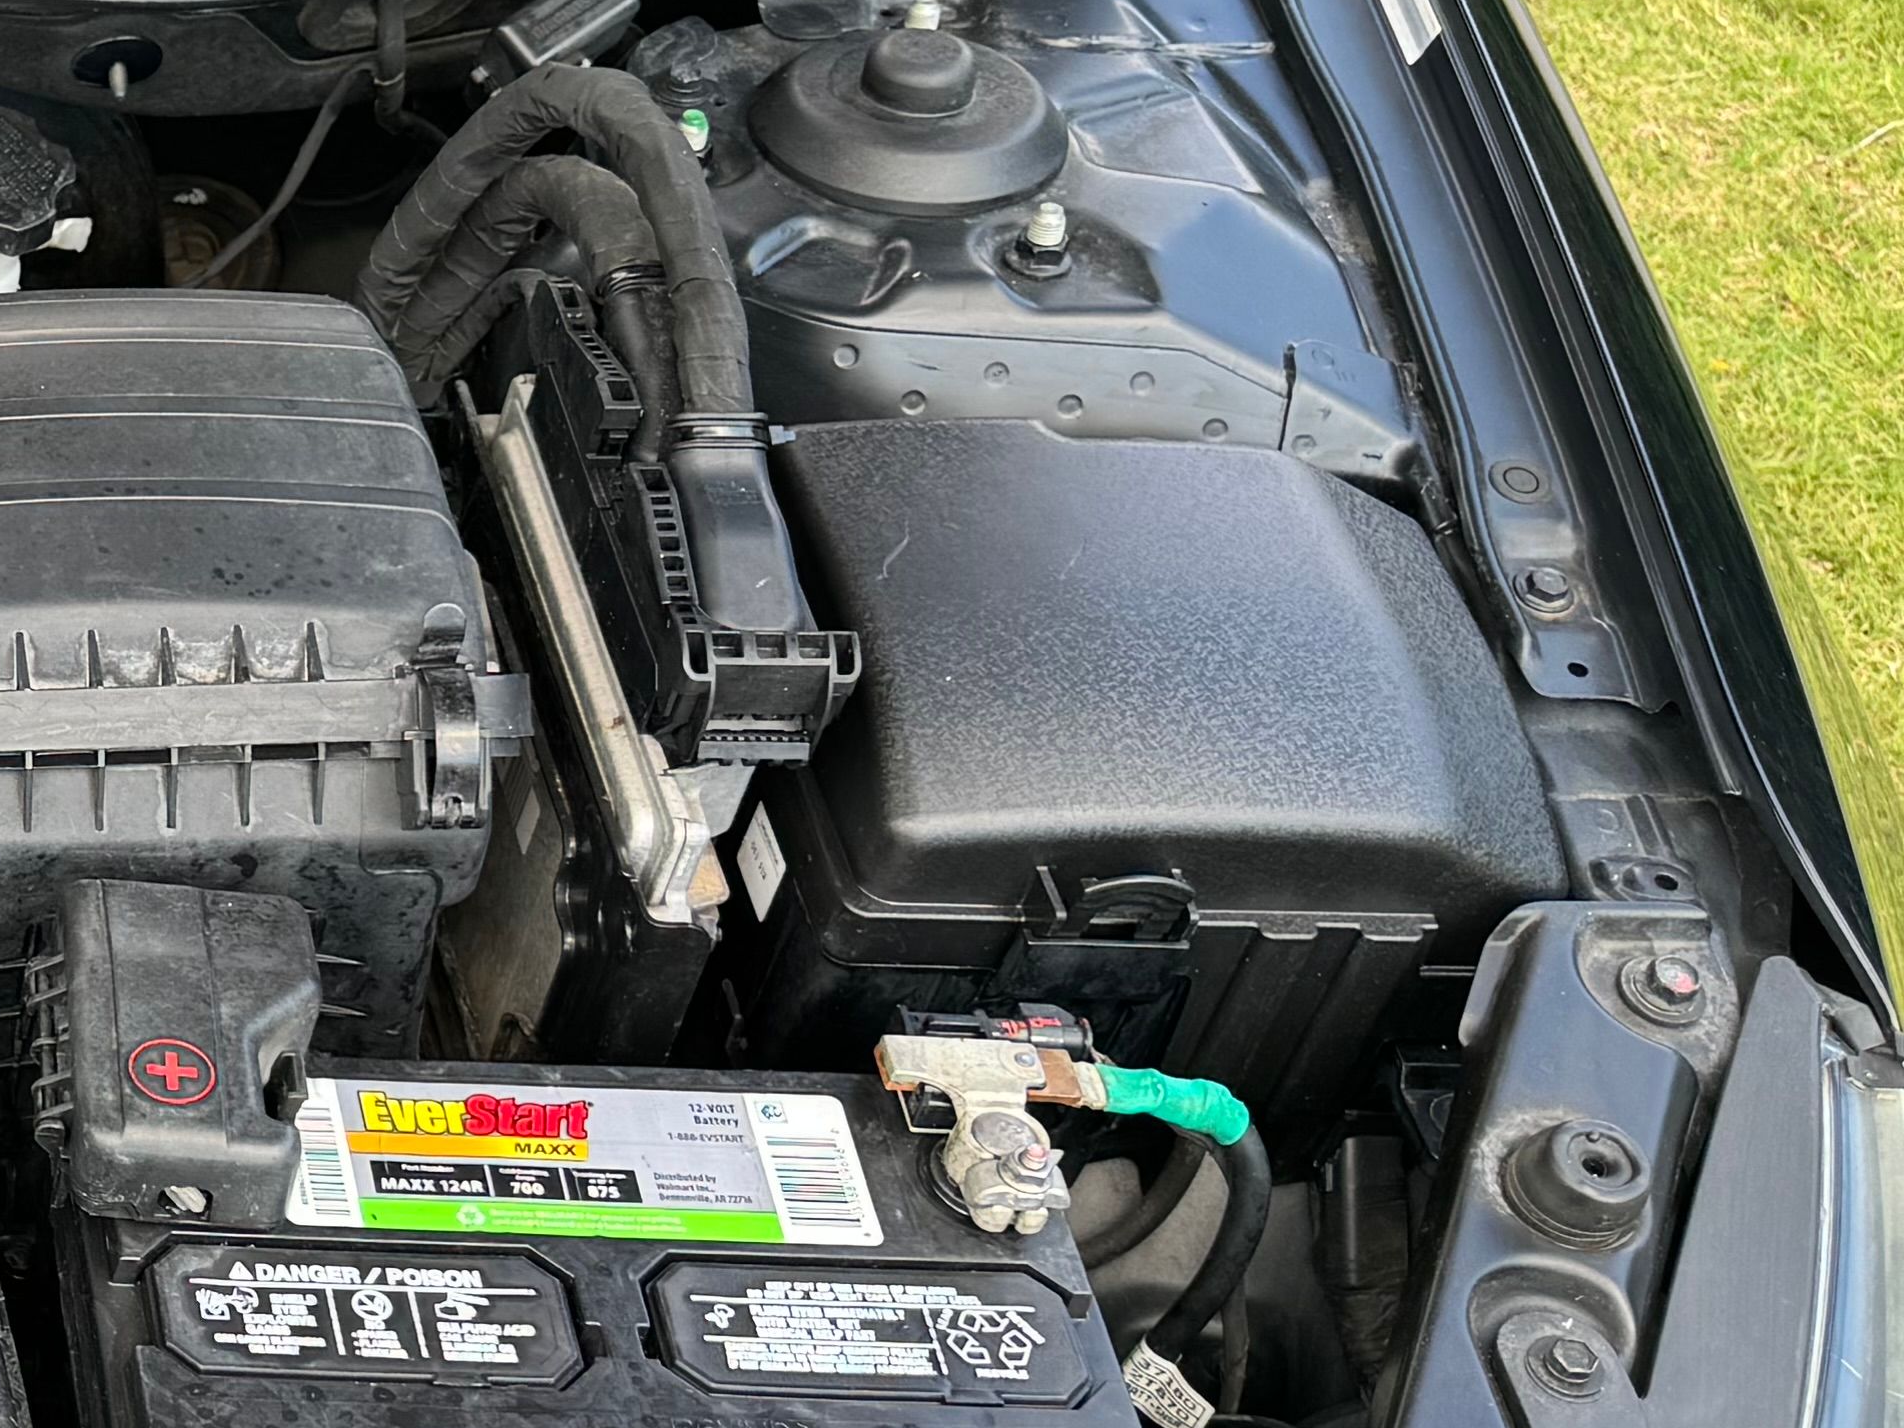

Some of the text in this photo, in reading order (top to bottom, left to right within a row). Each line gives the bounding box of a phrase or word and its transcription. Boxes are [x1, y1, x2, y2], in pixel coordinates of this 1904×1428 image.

[357, 1090, 588, 1139] EverStart
[688, 1102, 736, 1115] 12-VOLT
[693, 1115, 739, 1128] Battery
[514, 1141, 577, 1157] MAXX
[380, 1177, 487, 1194] MAXX 124R
[653, 1172, 717, 1185] Distributed by
[510, 1181, 546, 1197] 700
[587, 1184, 621, 1200] 875
[657, 1183, 695, 1193] Walmart
[255, 1263, 366, 1284] DANGER
[386, 1267, 484, 1288] POISON
[1137, 1357, 1197, 1411] 37180
[1130, 1368, 1190, 1421] 2T870
